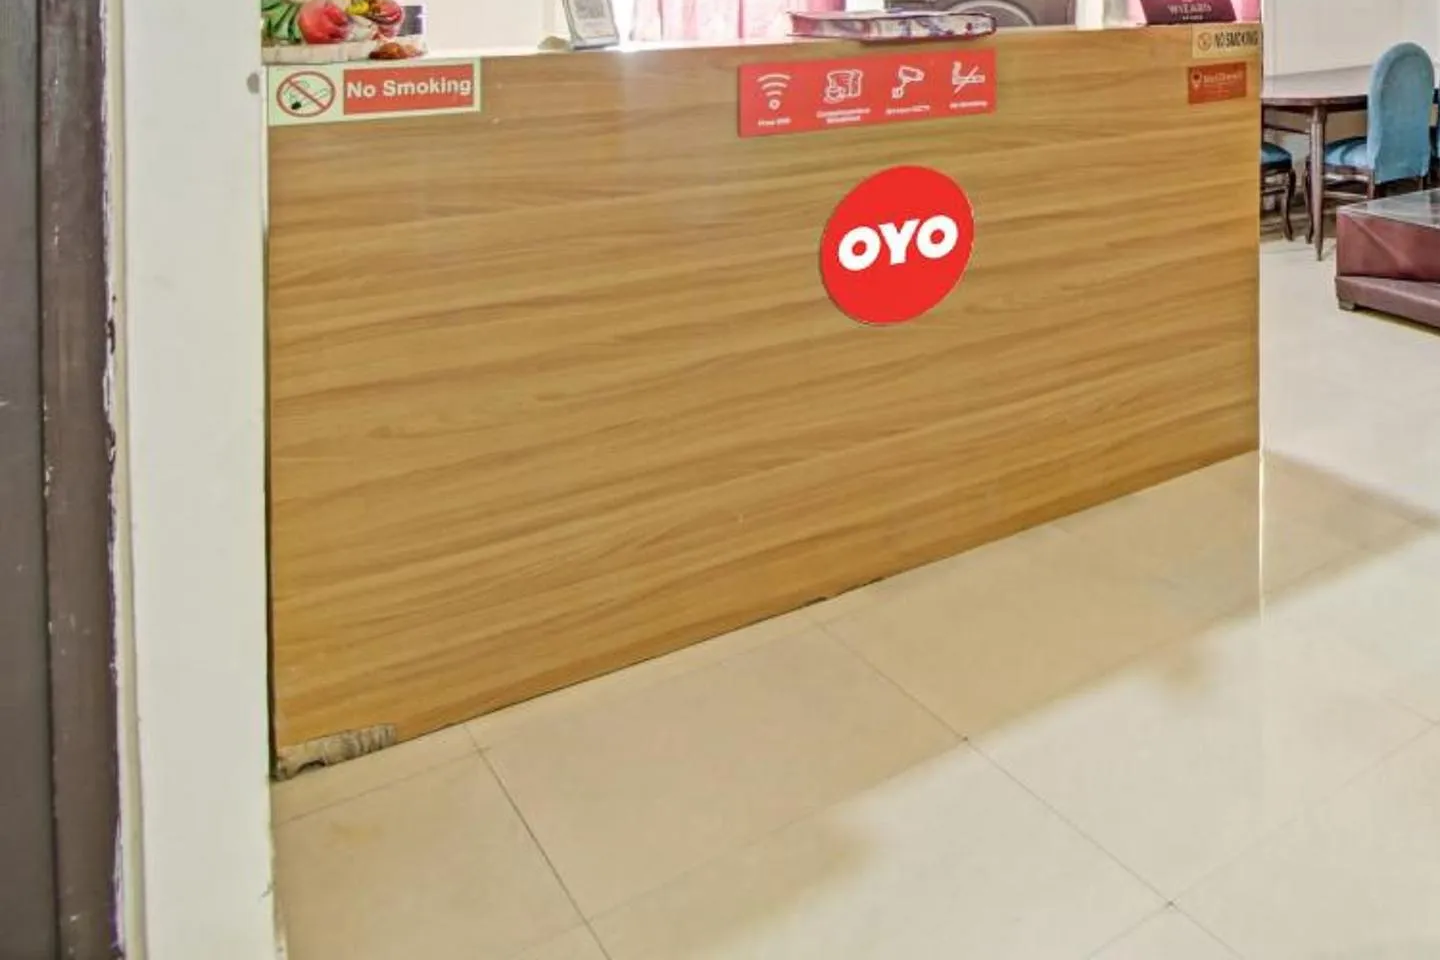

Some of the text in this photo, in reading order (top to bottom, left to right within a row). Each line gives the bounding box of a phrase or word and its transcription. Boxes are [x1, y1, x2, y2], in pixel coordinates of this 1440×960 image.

[346, 77, 472, 98] No Smoking
[838, 214, 960, 272] OYO
